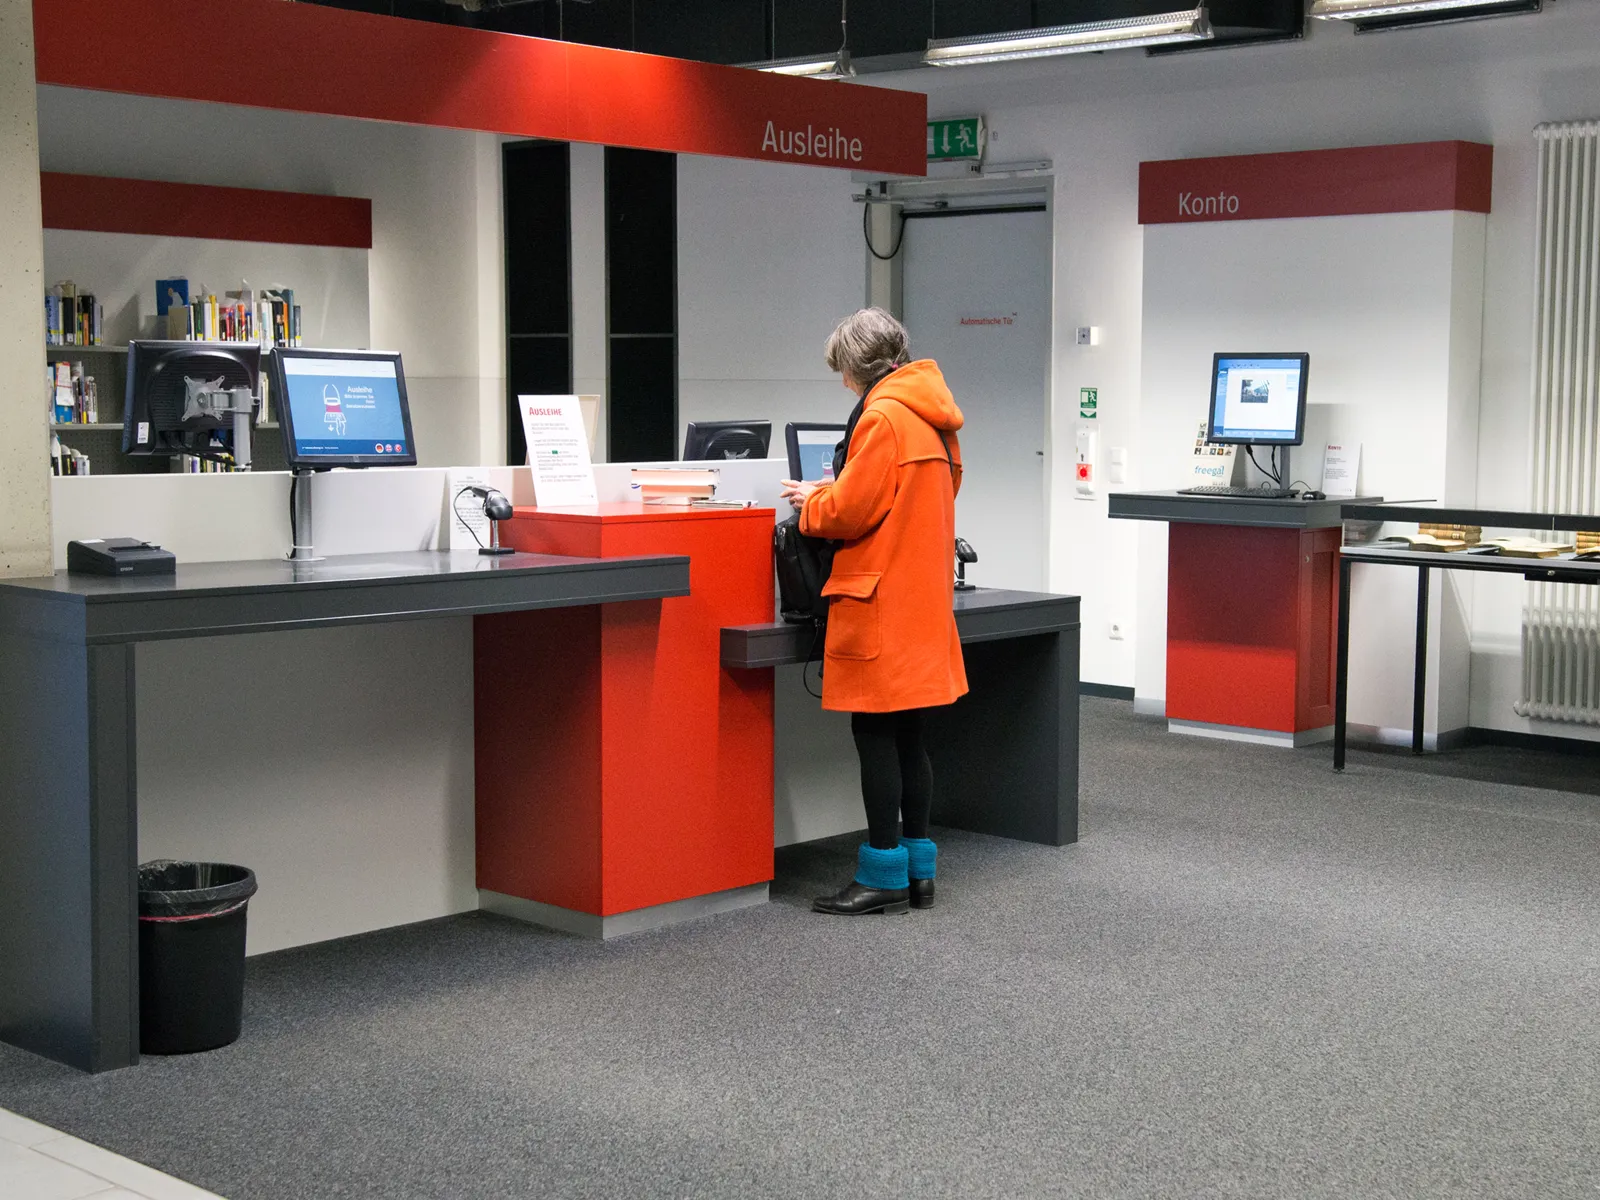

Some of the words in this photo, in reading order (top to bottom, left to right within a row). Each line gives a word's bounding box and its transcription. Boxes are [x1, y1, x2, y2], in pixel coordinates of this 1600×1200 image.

[761, 120, 862, 162] Ausleihe
[1178, 191, 1239, 216] Konto
[1195, 465, 1224, 476] freegal
